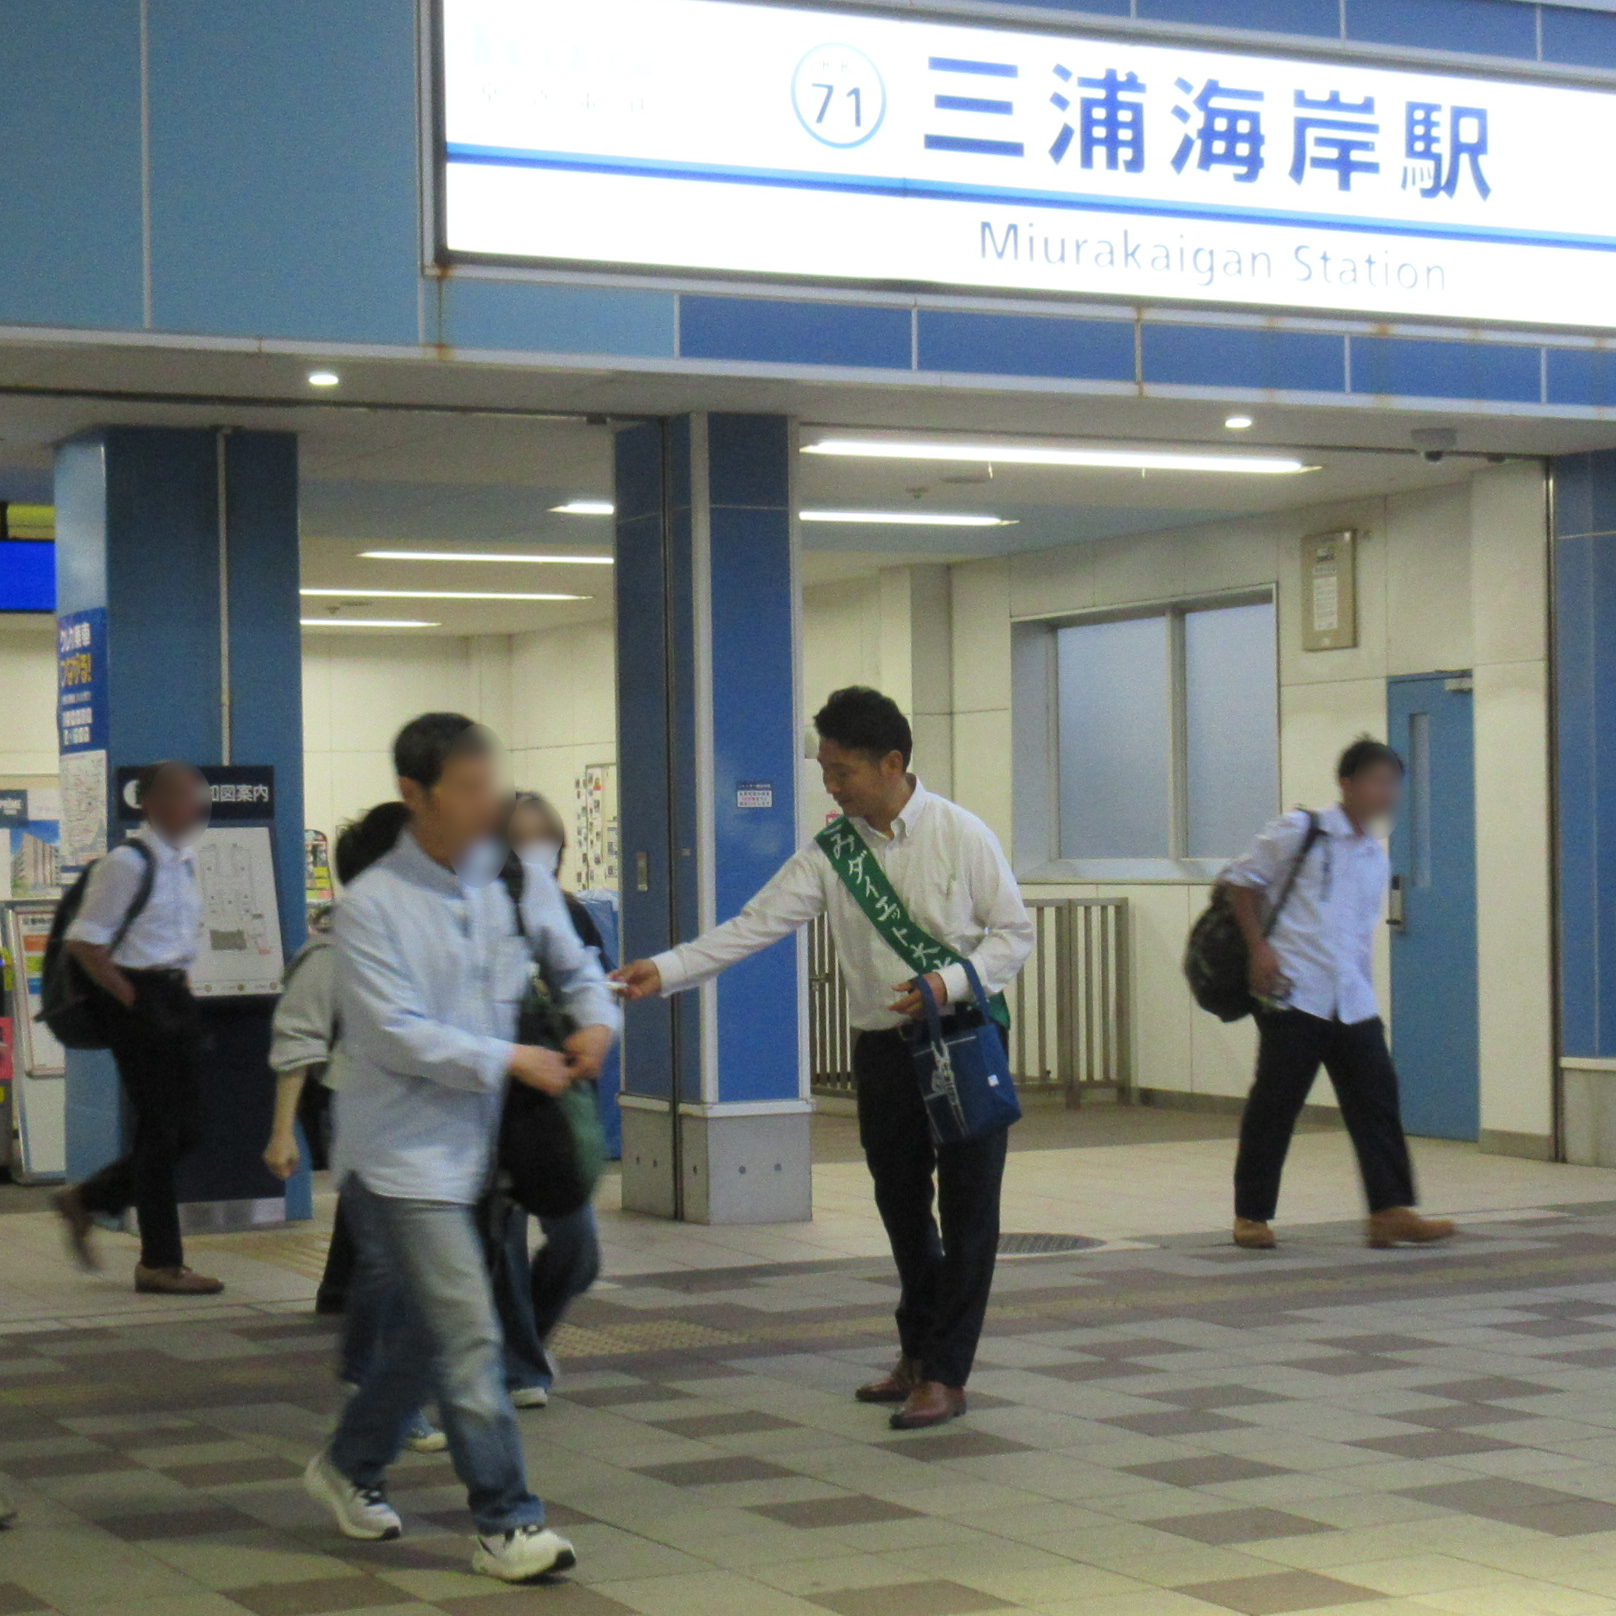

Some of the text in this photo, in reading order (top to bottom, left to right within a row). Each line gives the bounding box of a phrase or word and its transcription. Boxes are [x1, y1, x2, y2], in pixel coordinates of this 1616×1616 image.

[811, 83, 862, 127] 71
[924, 56, 1491, 201] 三浦海岸駅
[980, 221, 1446, 291] Miurakaigan Station
